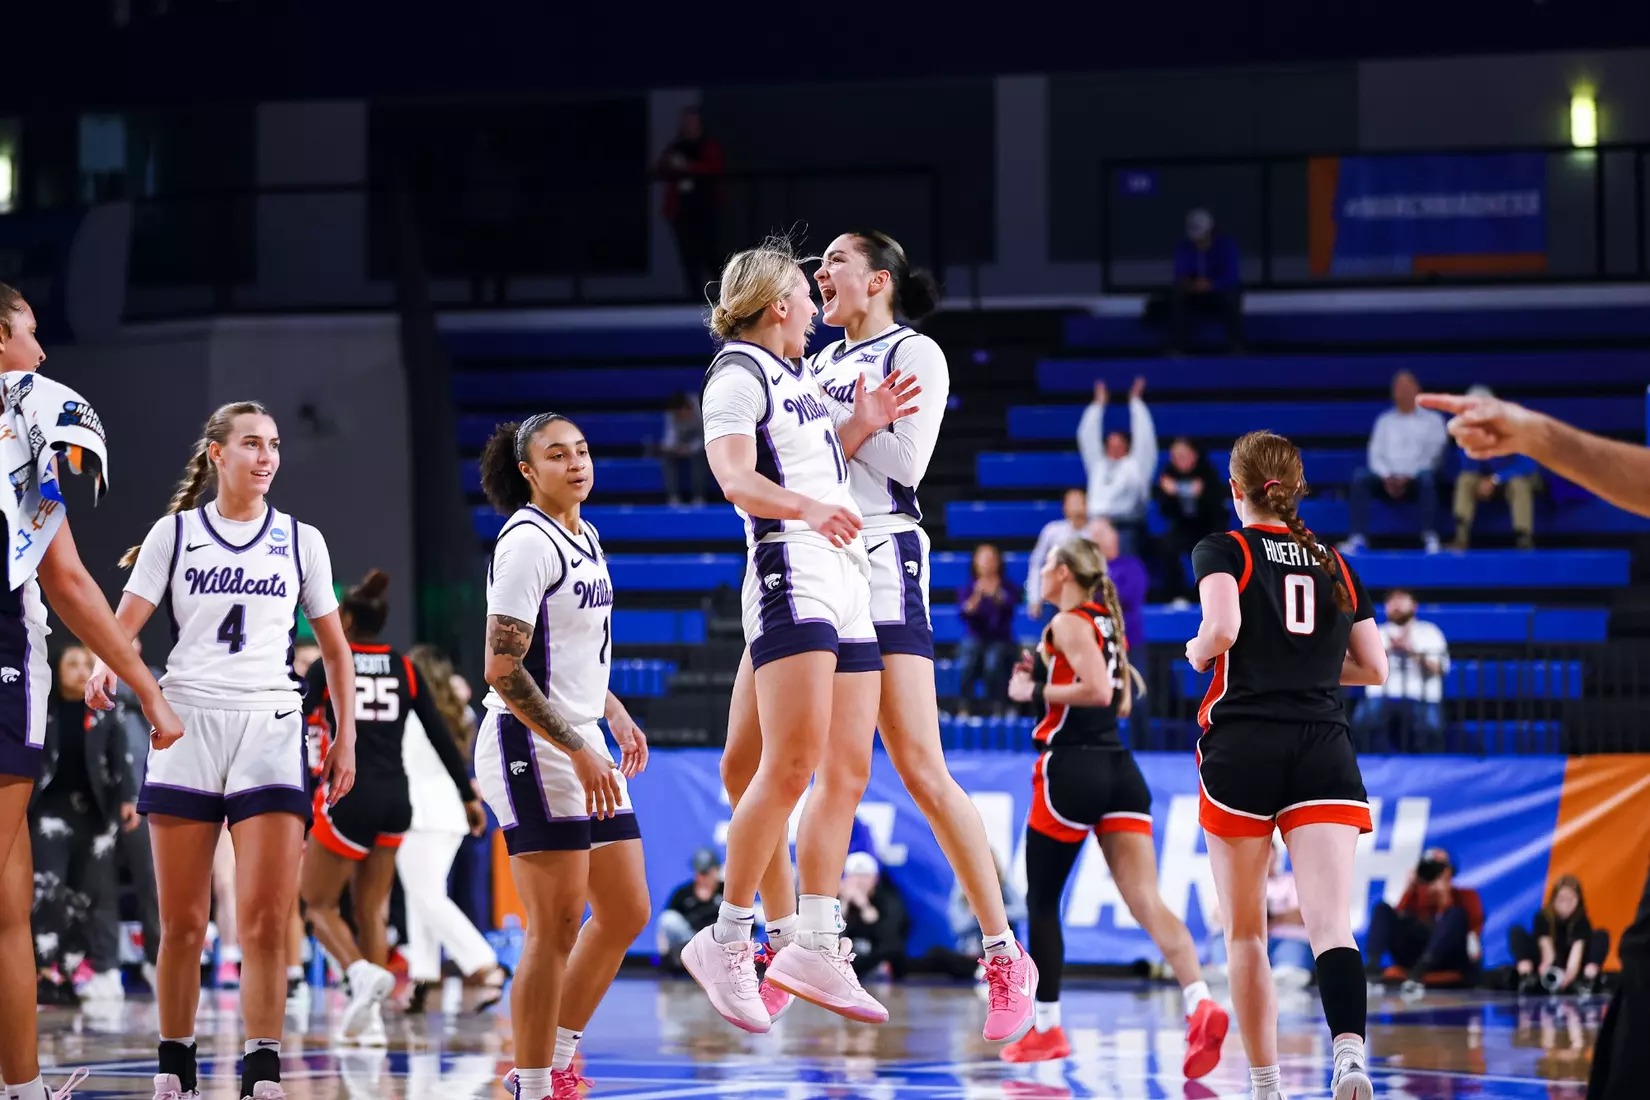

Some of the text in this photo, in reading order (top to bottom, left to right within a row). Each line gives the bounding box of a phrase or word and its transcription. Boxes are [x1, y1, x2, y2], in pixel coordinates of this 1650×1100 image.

[185, 566, 287, 597] Wildcats
[1284, 573, 1316, 636] 0
[217, 603, 246, 654] 4
[355, 676, 400, 722] 25
